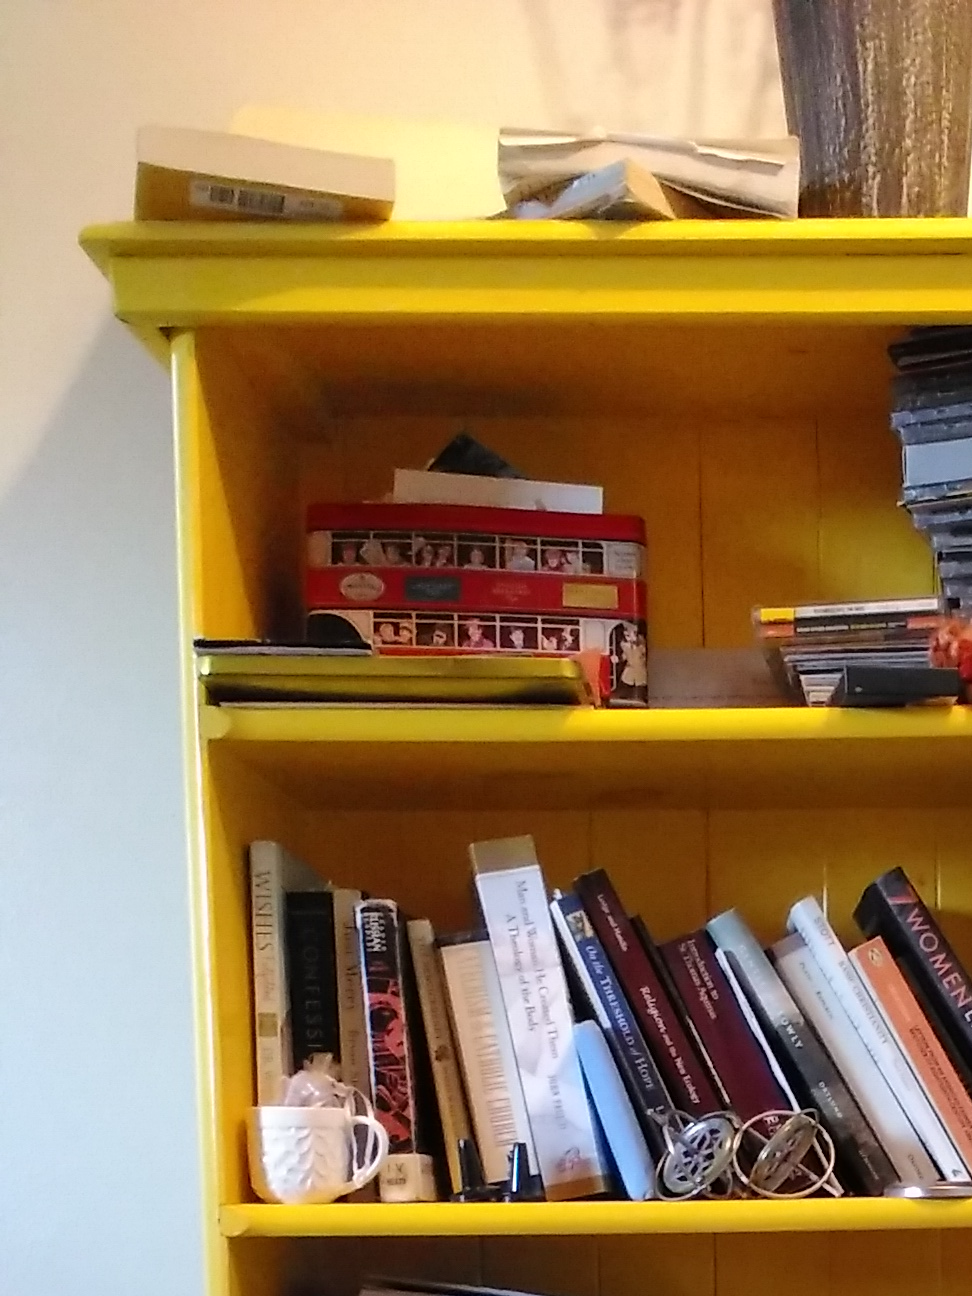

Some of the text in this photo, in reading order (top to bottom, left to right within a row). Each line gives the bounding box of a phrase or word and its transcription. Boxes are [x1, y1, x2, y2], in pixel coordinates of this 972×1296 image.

[254, 871, 272, 951] WISHES
[903, 911, 971, 1005] WOMEN
[300, 928, 323, 1047] CONFESSI
[505, 925, 527, 973] Theology
[523, 1005, 540, 1032] Body
[585, 944, 598, 961] On
[592, 960, 606, 975] the
[600, 977, 634, 1044] THRESHOLD
[638, 986, 668, 1032] Religion
